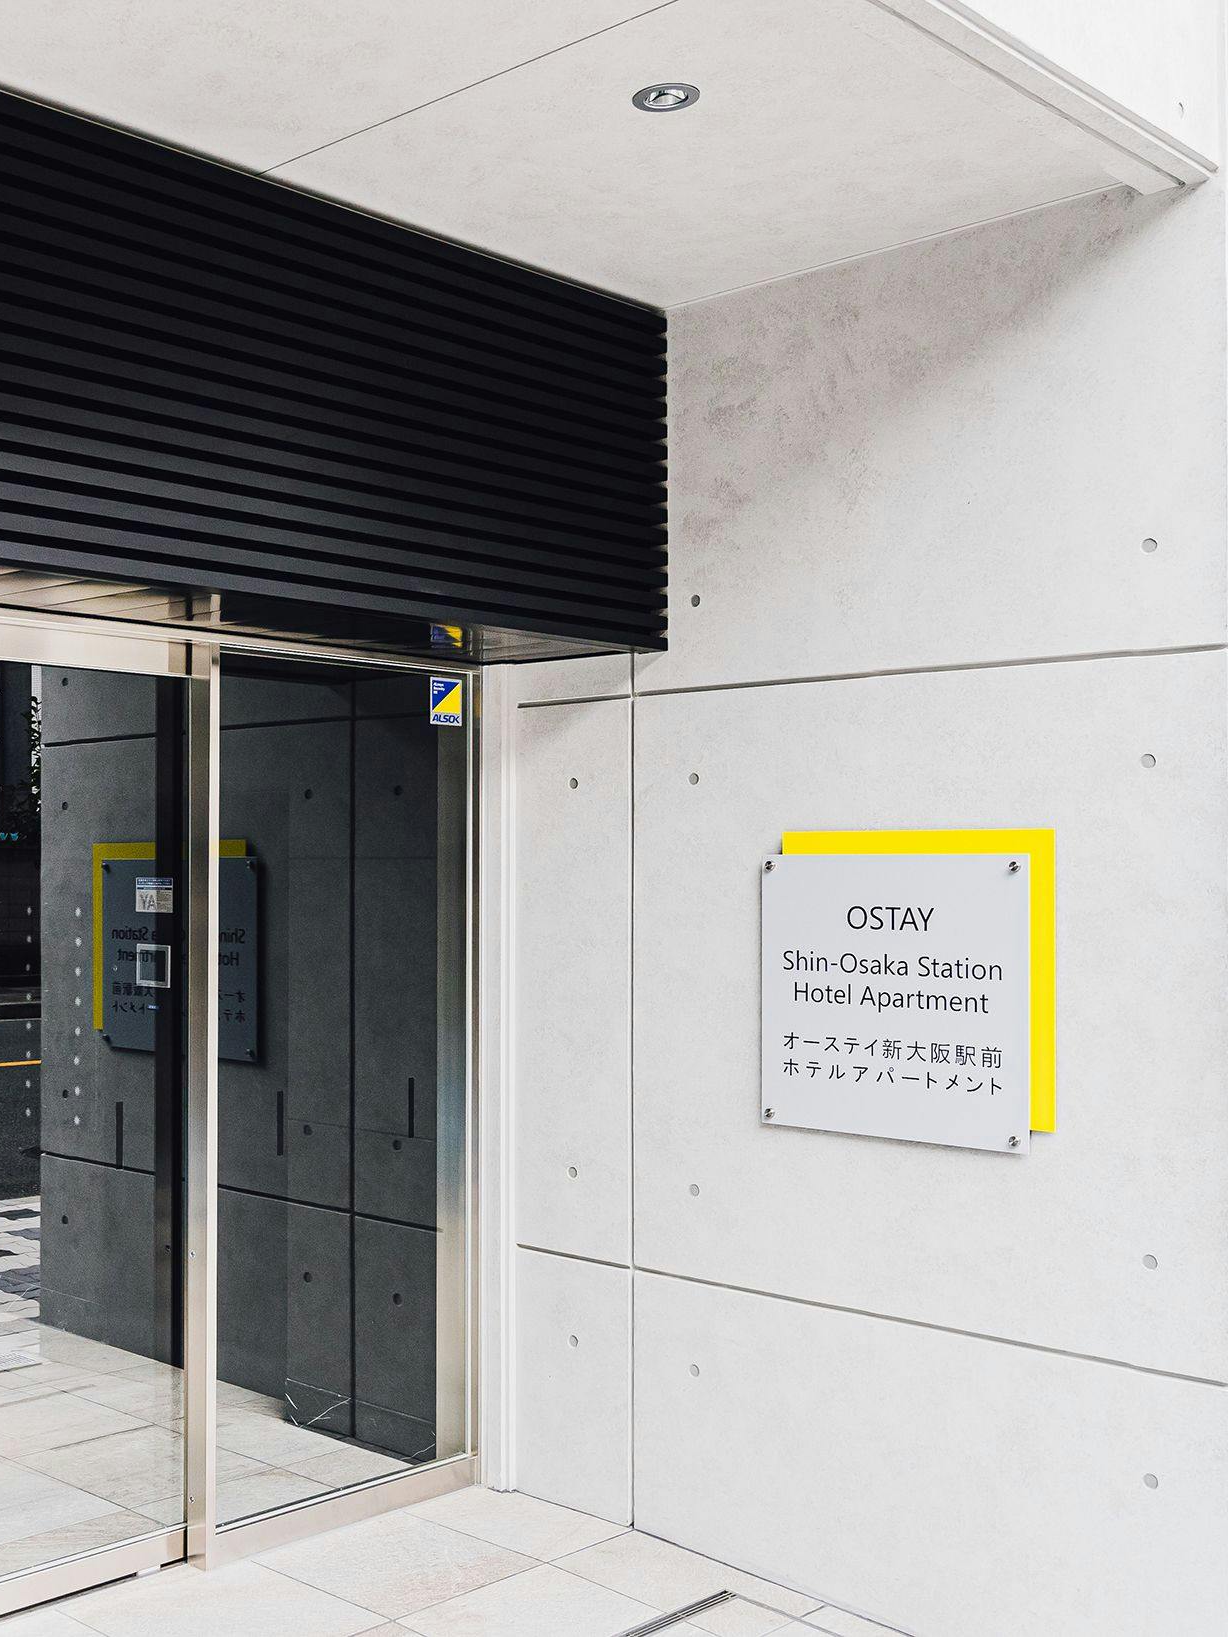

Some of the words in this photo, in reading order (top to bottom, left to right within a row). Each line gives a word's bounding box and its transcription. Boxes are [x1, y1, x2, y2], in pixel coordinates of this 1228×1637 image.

[432, 713, 461, 724] ALSOK
[846, 905, 935, 932] OSTAY
[782, 949, 909, 978] Shin-Osaka
[917, 955, 1003, 981] Station
[793, 980, 853, 1005] Hotel
[859, 985, 989, 1014] Apartment
[783, 1031, 1003, 1069] オーステイ新大阪駅前
[783, 1056, 1002, 1096] ホテルアパートメント
